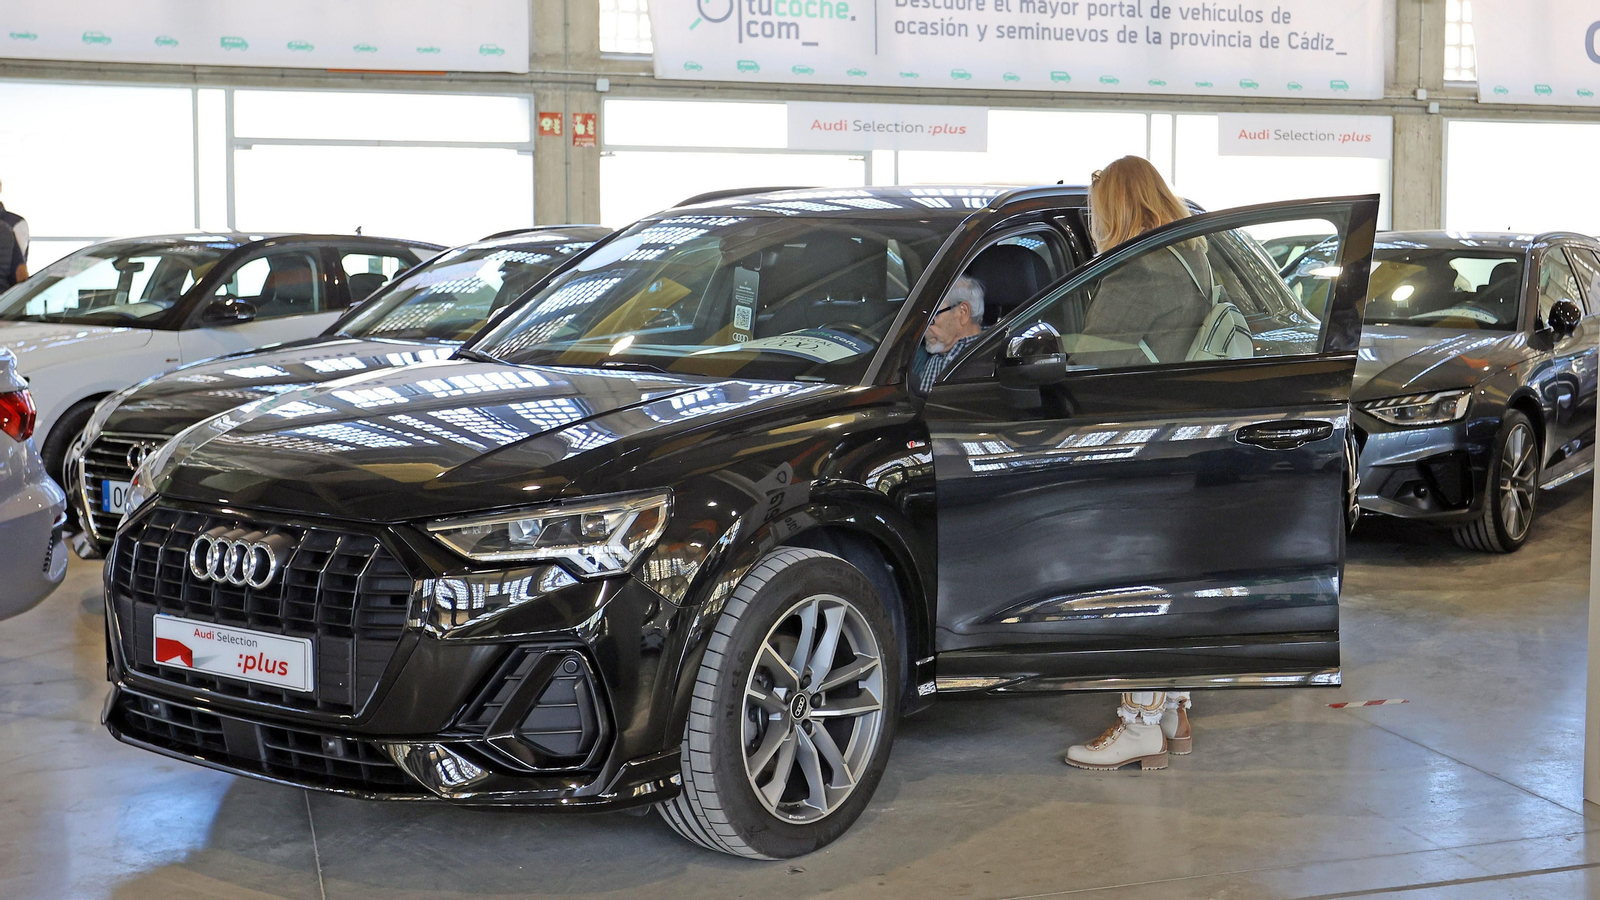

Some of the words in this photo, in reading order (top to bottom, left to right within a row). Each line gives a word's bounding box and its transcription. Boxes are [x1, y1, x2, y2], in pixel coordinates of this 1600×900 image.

[994, 0, 1012, 13] el
[1020, 0, 1079, 18] mayor
[1087, 0, 1143, 20] portal
[1150, 1, 1172, 19] de
[1179, 2, 1264, 23] vehículos
[1271, 6, 1292, 24] de
[895, 16, 969, 38] ocasión
[976, 23, 988, 42] y
[996, 22, 1109, 43] seminuevos
[1116, 25, 1138, 43] de
[1145, 25, 1162, 45] la
[1170, 29, 1252, 49] provincia
[1259, 31, 1280, 48] de
[811, 118, 848, 132] Audi
[852, 120, 924, 134] Selection
[928, 123, 967, 136] :plus
[1238, 129, 1270, 140] Audi
[1273, 129, 1335, 142] Selection
[1338, 131, 1372, 144] :plus
[193, 628, 215, 640] Audi
[216, 631, 258, 648] Selection
[237, 652, 289, 676] :plus
